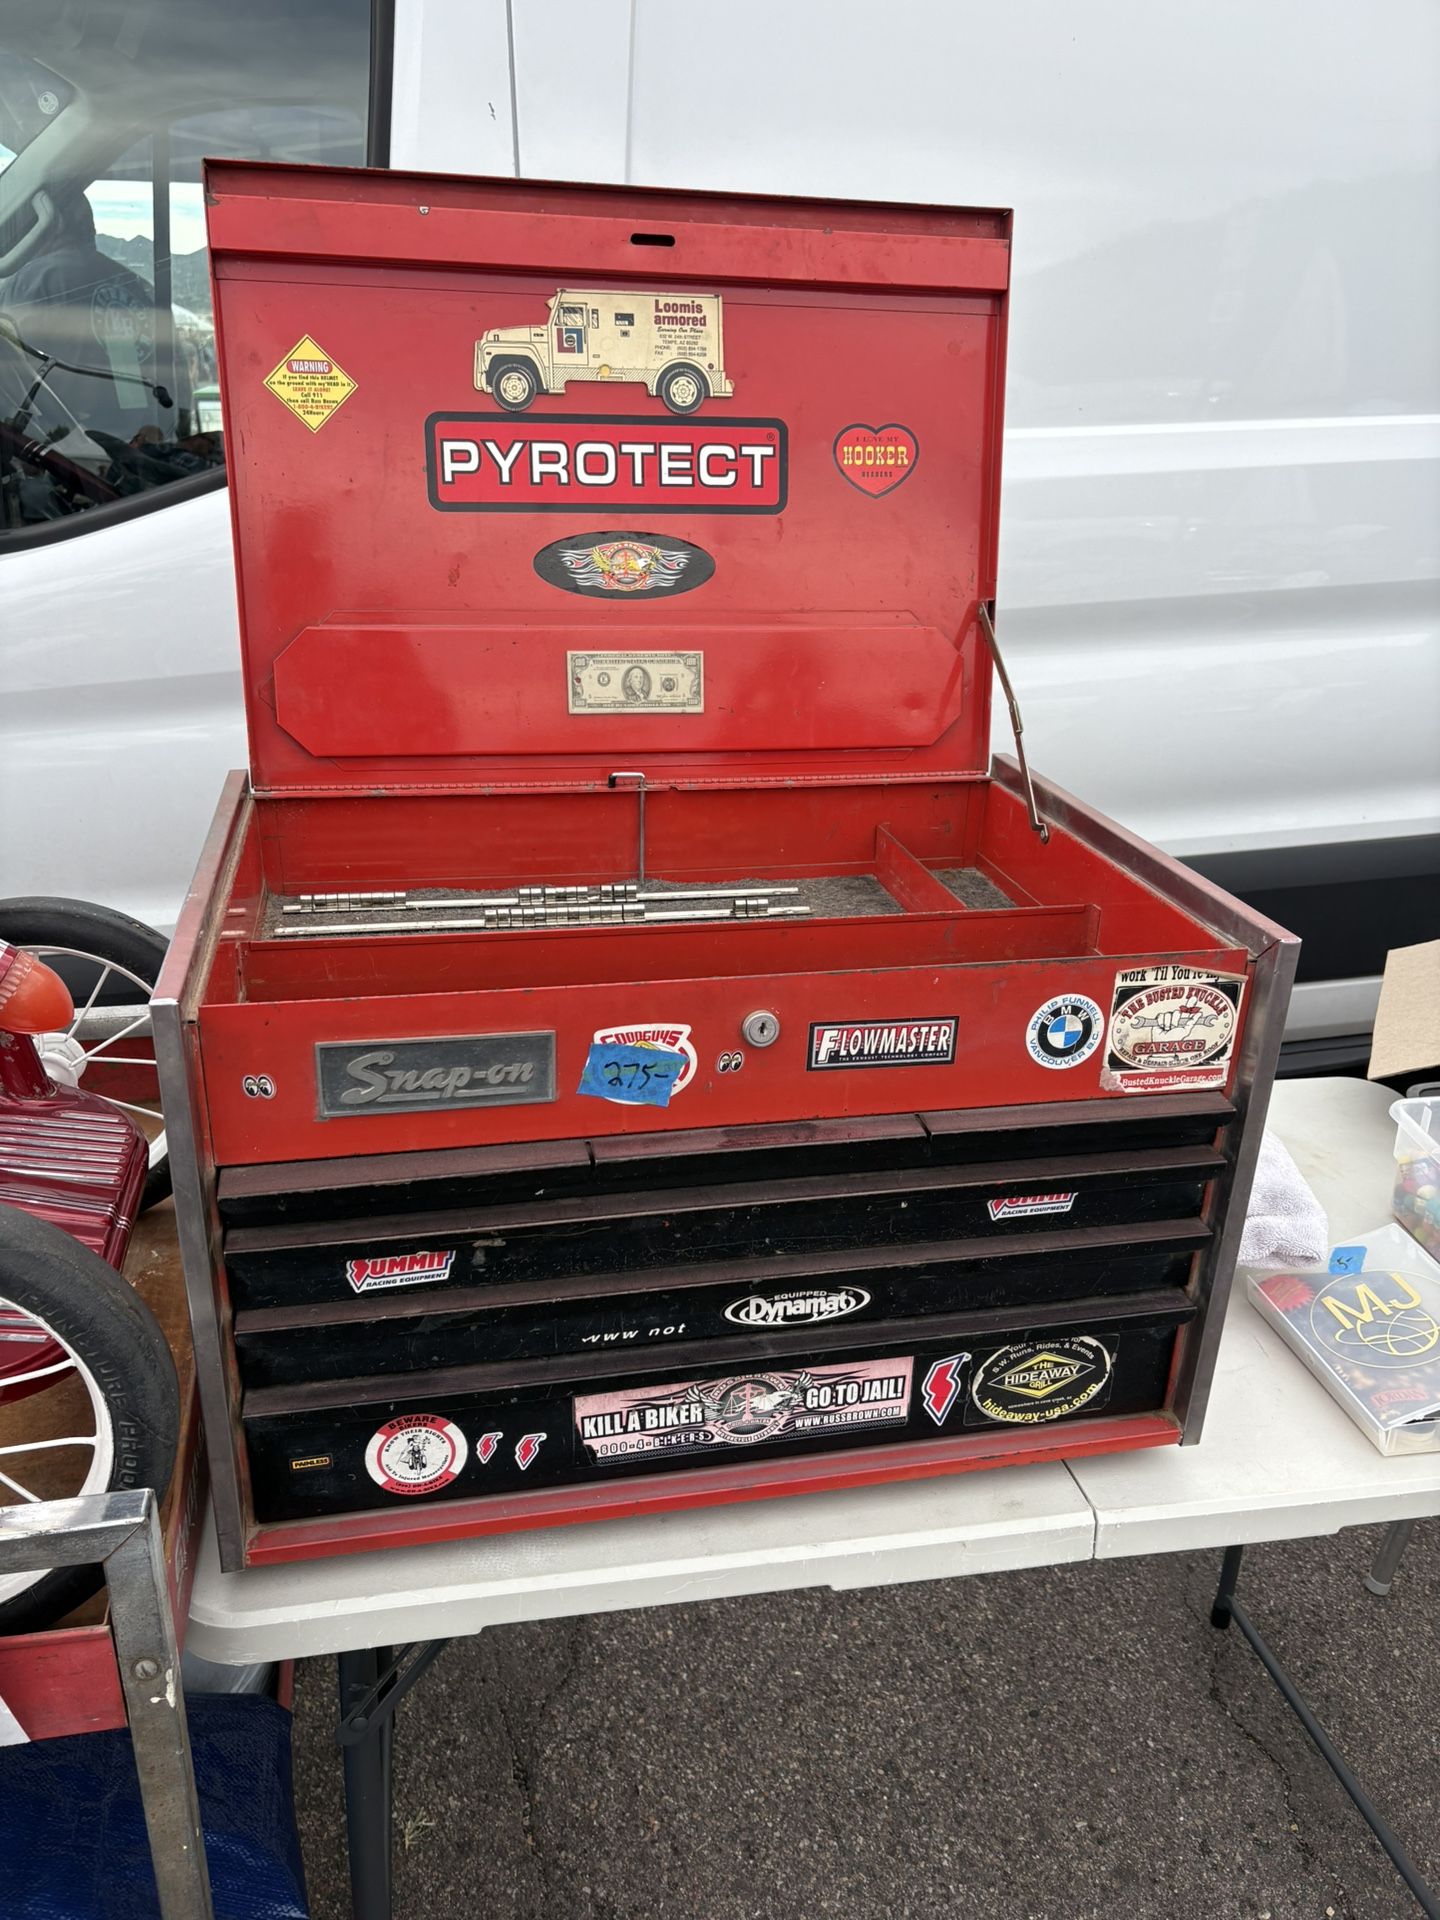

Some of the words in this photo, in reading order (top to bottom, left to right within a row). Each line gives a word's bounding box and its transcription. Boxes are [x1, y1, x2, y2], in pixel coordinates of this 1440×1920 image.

[655, 299, 703, 314] Loomis
[654, 315, 707, 327] armored
[292, 361, 329, 373] WARNING
[440, 438, 776, 488] PYROTECT
[843, 445, 909, 465] HOOKER
[1121, 999, 1146, 1020] THE
[1145, 986, 1186, 1006] BUSTED
[1186, 986, 1229, 1016] KNUCKLE
[1031, 1001, 1058, 1031] PHILIP
[1062, 997, 1101, 1025] FUNNELL
[1043, 1006, 1089, 1026] BMW
[817, 1025, 950, 1063] FLOWMASTER
[1030, 1038, 1086, 1066] VANCOUVER
[1134, 1040, 1206, 1054] GARAGE
[341, 1051, 534, 1104] Snap-on
[1002, 1208, 1028, 1216] RACING
[1030, 1204, 1070, 1213] EQUIPMENT
[366, 1278, 397, 1288] RACING
[399, 1272, 448, 1284] EQUIPMENT
[774, 1290, 828, 1301] EQUIPPED
[1321, 1272, 1422, 1330] MJ
[750, 1291, 848, 1322] Dynamat
[648, 1323, 687, 1337] not
[1010, 1348, 1035, 1360] Runs,
[1036, 1343, 1062, 1351] Rides,
[1072, 1343, 1095, 1360] Events
[1005, 1364, 1080, 1386] HIDEAWAY
[1032, 1362, 1054, 1370] THE
[806, 1386, 832, 1409] GO
[835, 1382, 860, 1405] TO
[861, 1377, 904, 1402] JAIL!
[1029, 1379, 1053, 1390] GRILL
[982, 1383, 1099, 1422] hideaway-usa.com
[388, 1416, 438, 1430] BEWARE
[399, 1422, 428, 1431] BIKERS
[583, 1415, 624, 1438] KILL
[627, 1412, 642, 1432] A
[645, 1403, 703, 1430] BIKER
[795, 1406, 901, 1428] WWW.RUSSBROWN.COM
[385, 1436, 399, 1453] KNOW
[400, 1428, 423, 1437] THEIR
[425, 1429, 447, 1444] RIGHTS
[118, 1420, 144, 1491] PROO
[294, 1459, 328, 1468] PAINLESS
